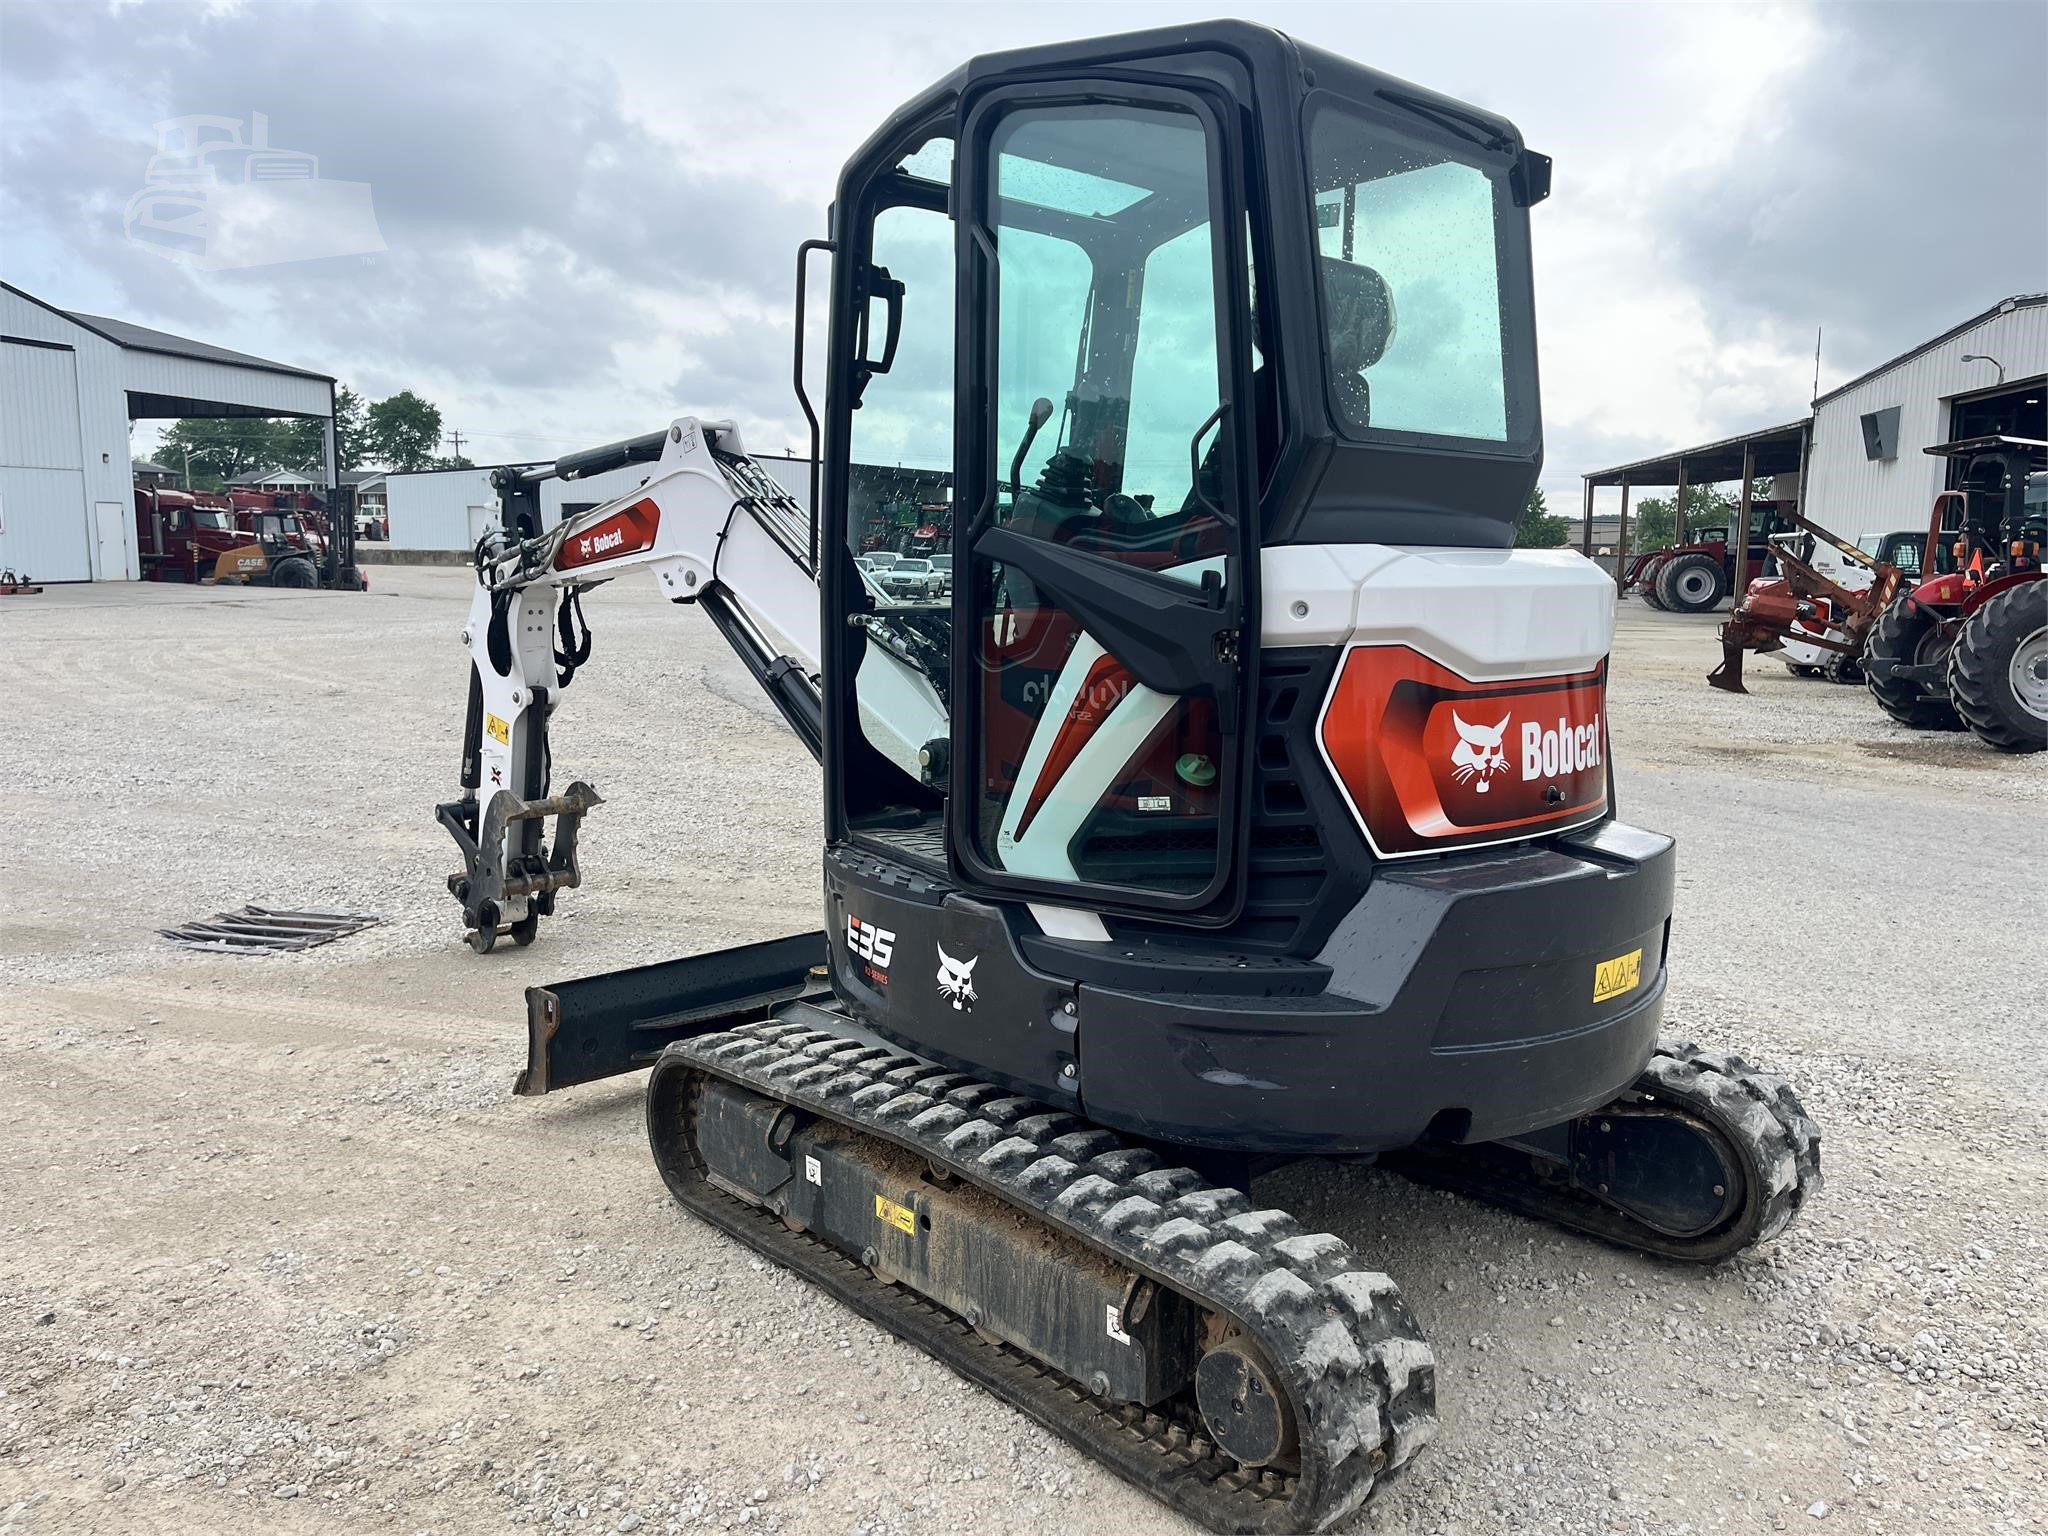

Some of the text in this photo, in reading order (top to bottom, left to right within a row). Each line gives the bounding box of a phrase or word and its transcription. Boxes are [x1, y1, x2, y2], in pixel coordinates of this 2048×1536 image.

[593, 528, 623, 553] Bobcat
[237, 558, 265, 567] CASE
[1521, 713, 1600, 781] Bobcat
[847, 914, 896, 969] E35
